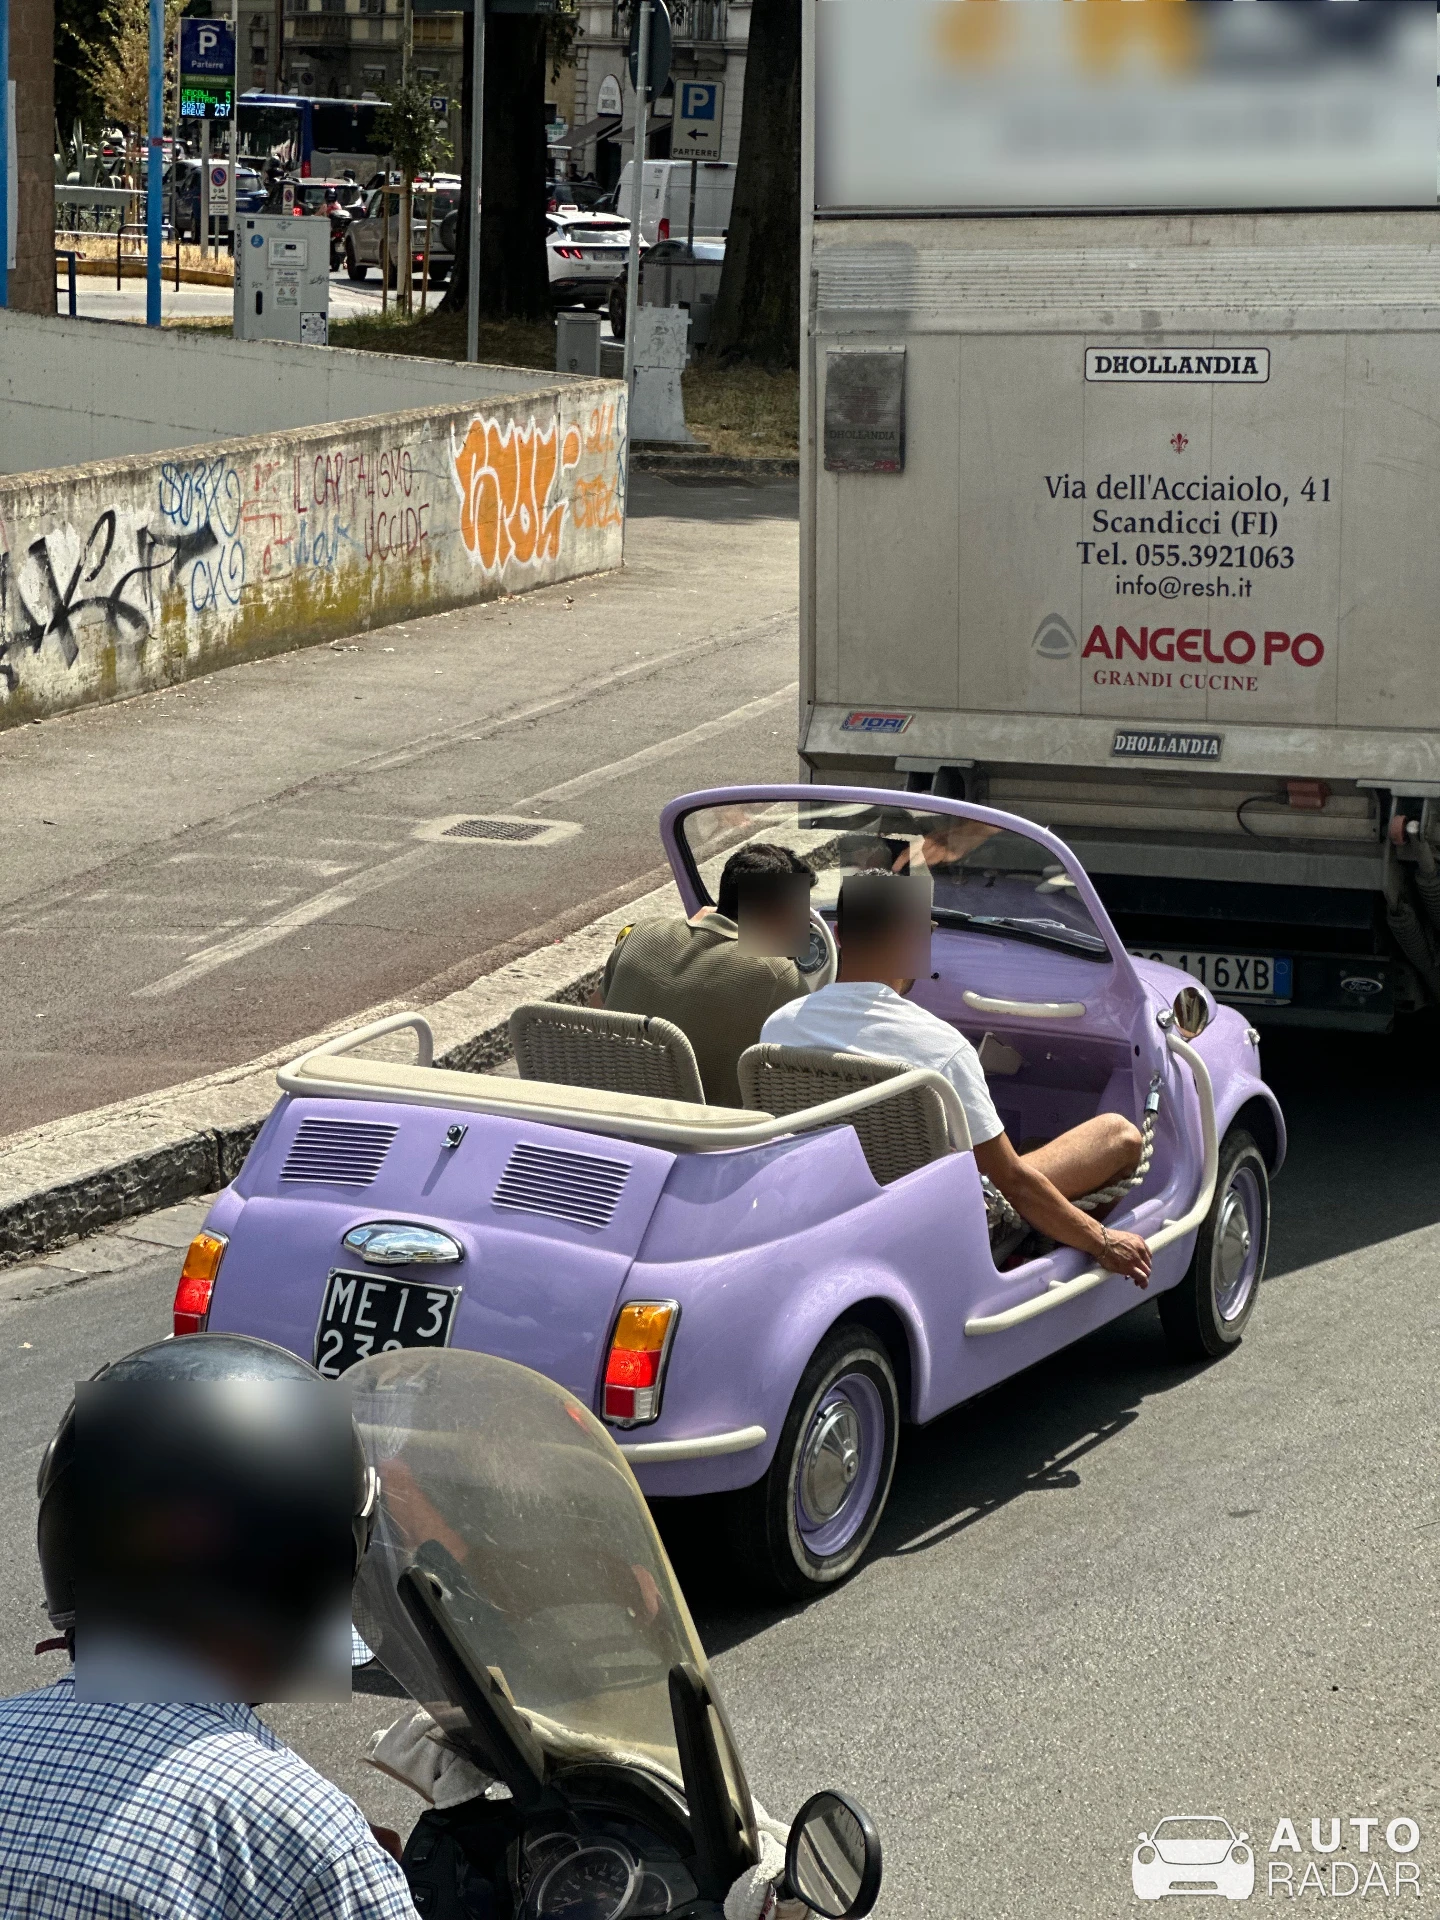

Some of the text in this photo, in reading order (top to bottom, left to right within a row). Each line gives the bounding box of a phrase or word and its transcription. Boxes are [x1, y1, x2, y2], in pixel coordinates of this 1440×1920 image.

[191, 60, 224, 69] Parterre
[181, 96, 218, 104] ELETTRICI
[225, 91, 231, 103] 5
[214, 103, 231, 117] 257
[673, 148, 718, 157] PARTERRE
[1094, 355, 1259, 375] DHOLLANDIA
[829, 430, 895, 441] DHOLLANDIA
[1044, 474, 1331, 507] Via dell'Acciaiolo, 41
[1092, 509, 1278, 538] Scandicci (FI)
[364, 503, 430, 566] UCCIDE
[1076, 541, 1295, 569] Tel. 055.3921063
[1115, 574, 1253, 600] info@resh.it
[1081, 624, 1325, 667] ANGELO PO
[1093, 669, 1258, 692] GRANDI CUCINE
[848, 711, 907, 729] FIORI
[1114, 734, 1219, 755] DHOLLANDIA
[1349, 979, 1373, 992] Ford
